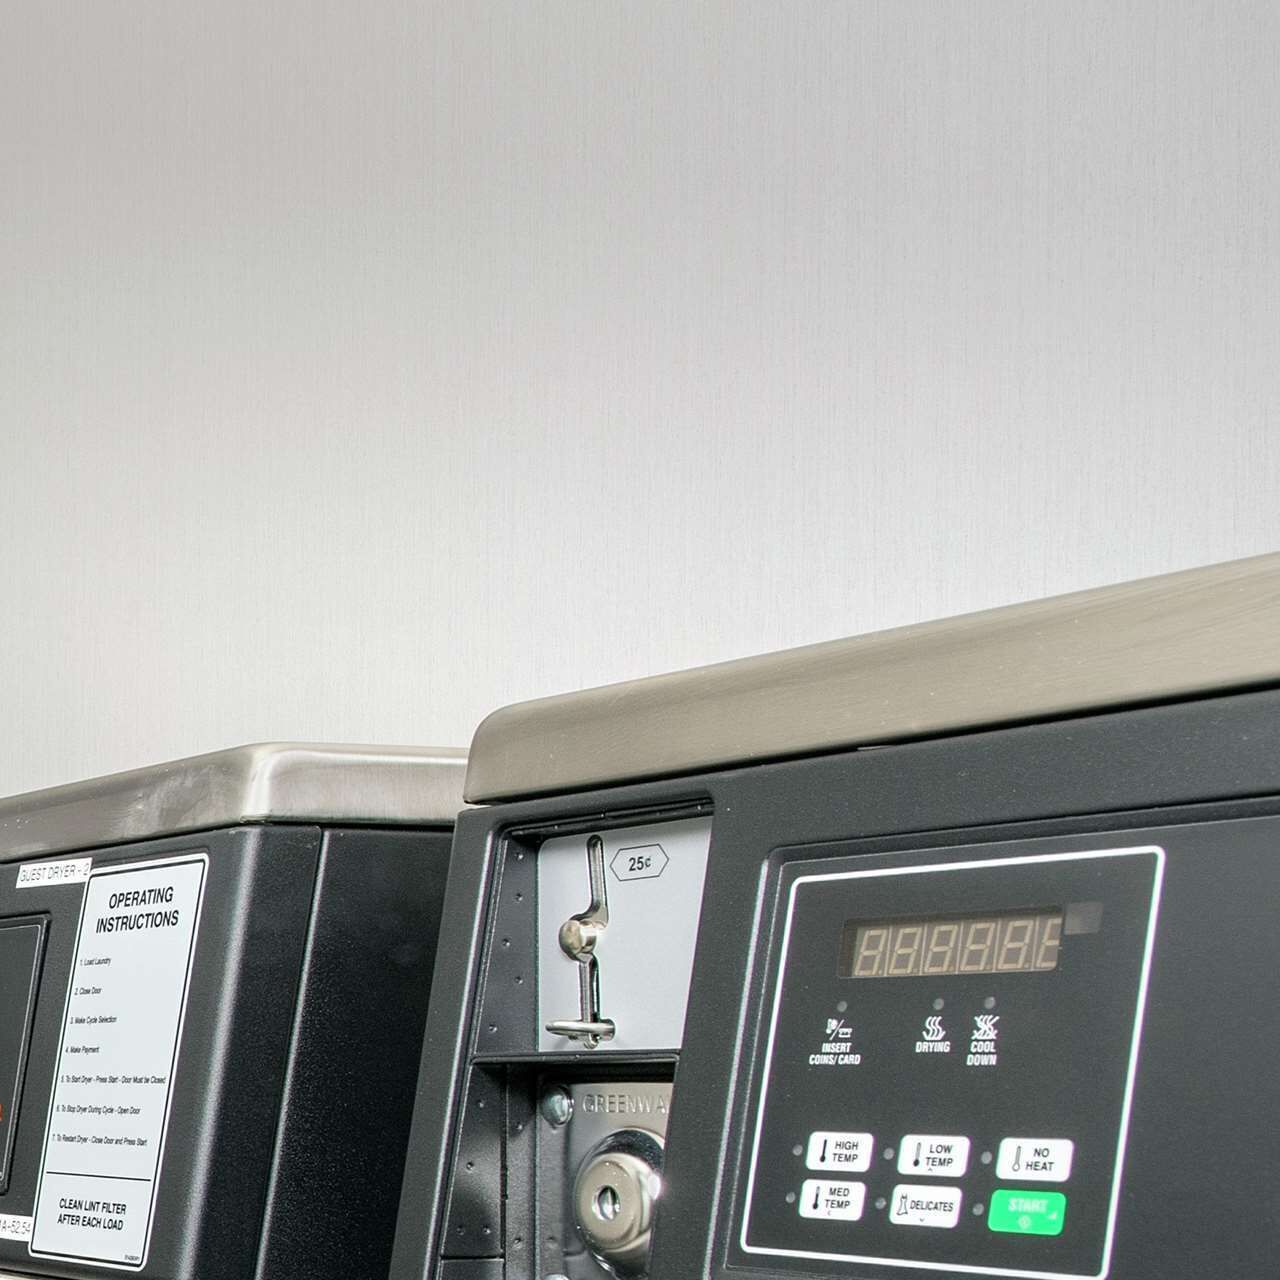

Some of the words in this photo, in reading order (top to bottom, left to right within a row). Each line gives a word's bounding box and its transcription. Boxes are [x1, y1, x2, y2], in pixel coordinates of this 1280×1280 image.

[20, 866, 47, 882] GUEST
[48, 864, 76, 880] DRYER
[109, 886, 174, 909] OPERATING
[96, 910, 179, 933] INSTRUCTIONS
[821, 1042, 852, 1053] INSERT
[915, 1041, 951, 1053] DRYING
[970, 1041, 996, 1053] COOL
[966, 1054, 997, 1066] DOWN
[834, 1140, 859, 1151] HIGH
[929, 1144, 953, 1155] LOW
[832, 1153, 859, 1163] TEMP
[1033, 1148, 1050, 1158] NO
[925, 1157, 954, 1167] TEMP
[1025, 1161, 1054, 1172] HEAT
[828, 1187, 850, 1197] MED
[59, 1198, 83, 1211] CLEAN
[84, 1200, 101, 1212] LINT
[101, 1201, 126, 1215] FILTER
[824, 1199, 850, 1209] TEMP
[910, 1199, 954, 1212] DELICATES
[1008, 1197, 1049, 1213] START
[57, 1213, 80, 1226] AFTER
[81, 1216, 101, 1229] EACH
[102, 1218, 124, 1231] LOAD
